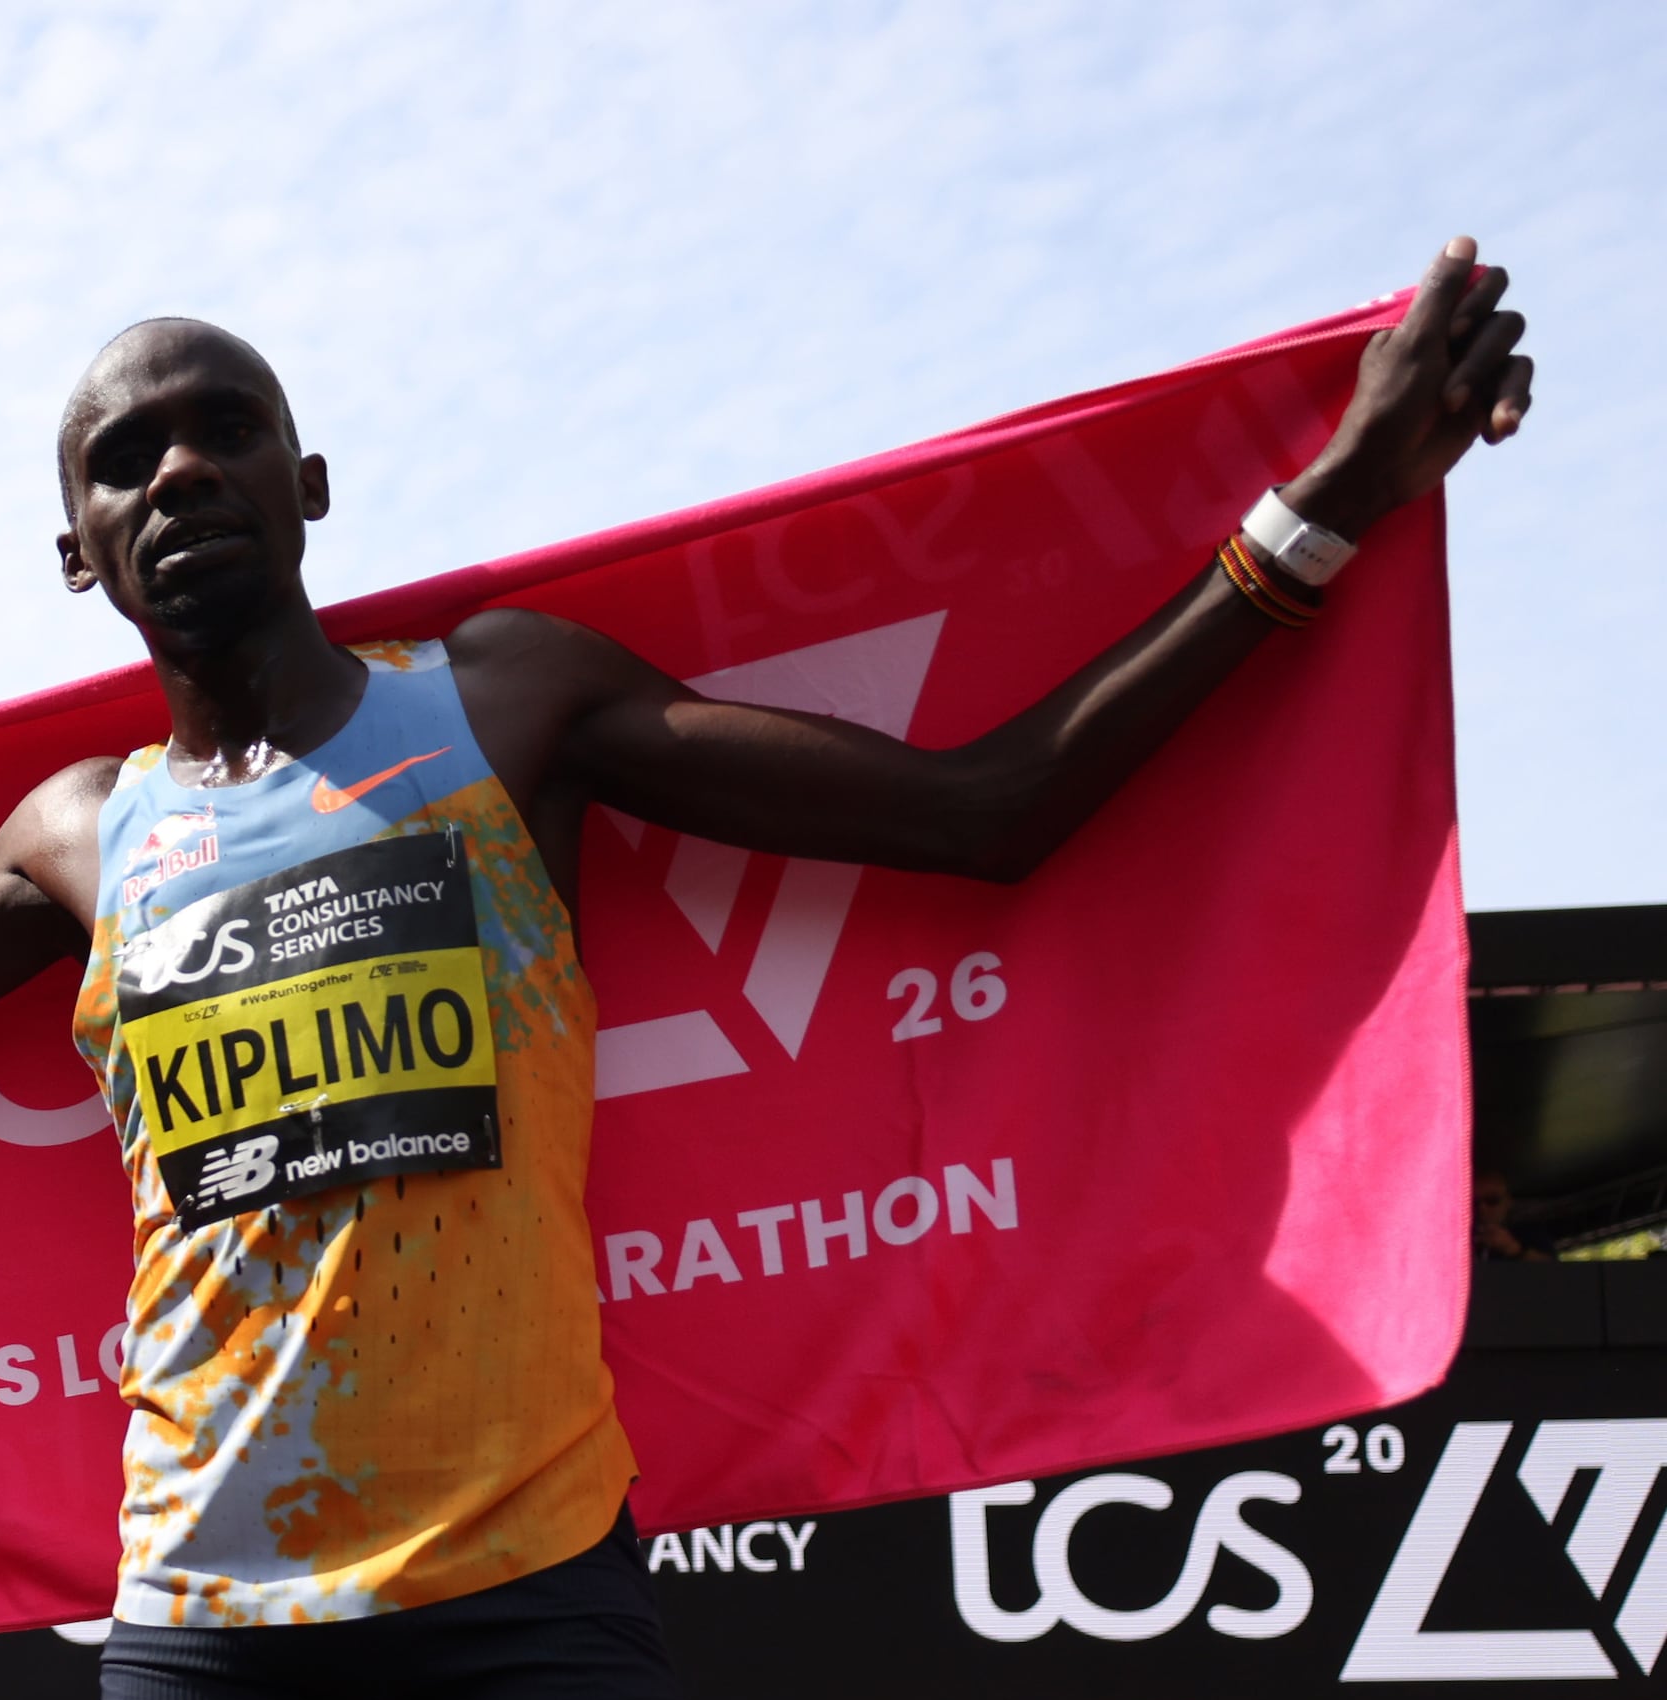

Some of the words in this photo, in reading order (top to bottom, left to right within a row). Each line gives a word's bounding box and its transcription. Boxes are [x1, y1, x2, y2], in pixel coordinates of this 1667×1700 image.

[264, 875, 340, 915] TATA
[267, 880, 446, 939] CONSULTANCY
[269, 914, 385, 963] SERVICES
[238, 969, 356, 1008] #WeRunTogether
[886, 951, 1008, 1045] 26
[146, 987, 476, 1134] KIPLIMO
[284, 1146, 345, 1183] new
[348, 1127, 472, 1164] balance
[595, 1156, 1021, 1306] RATHON
[645, 1520, 817, 1575] ANCY
[948, 1469, 1315, 1643] tcs
[1321, 1424, 1406, 1477] 20
